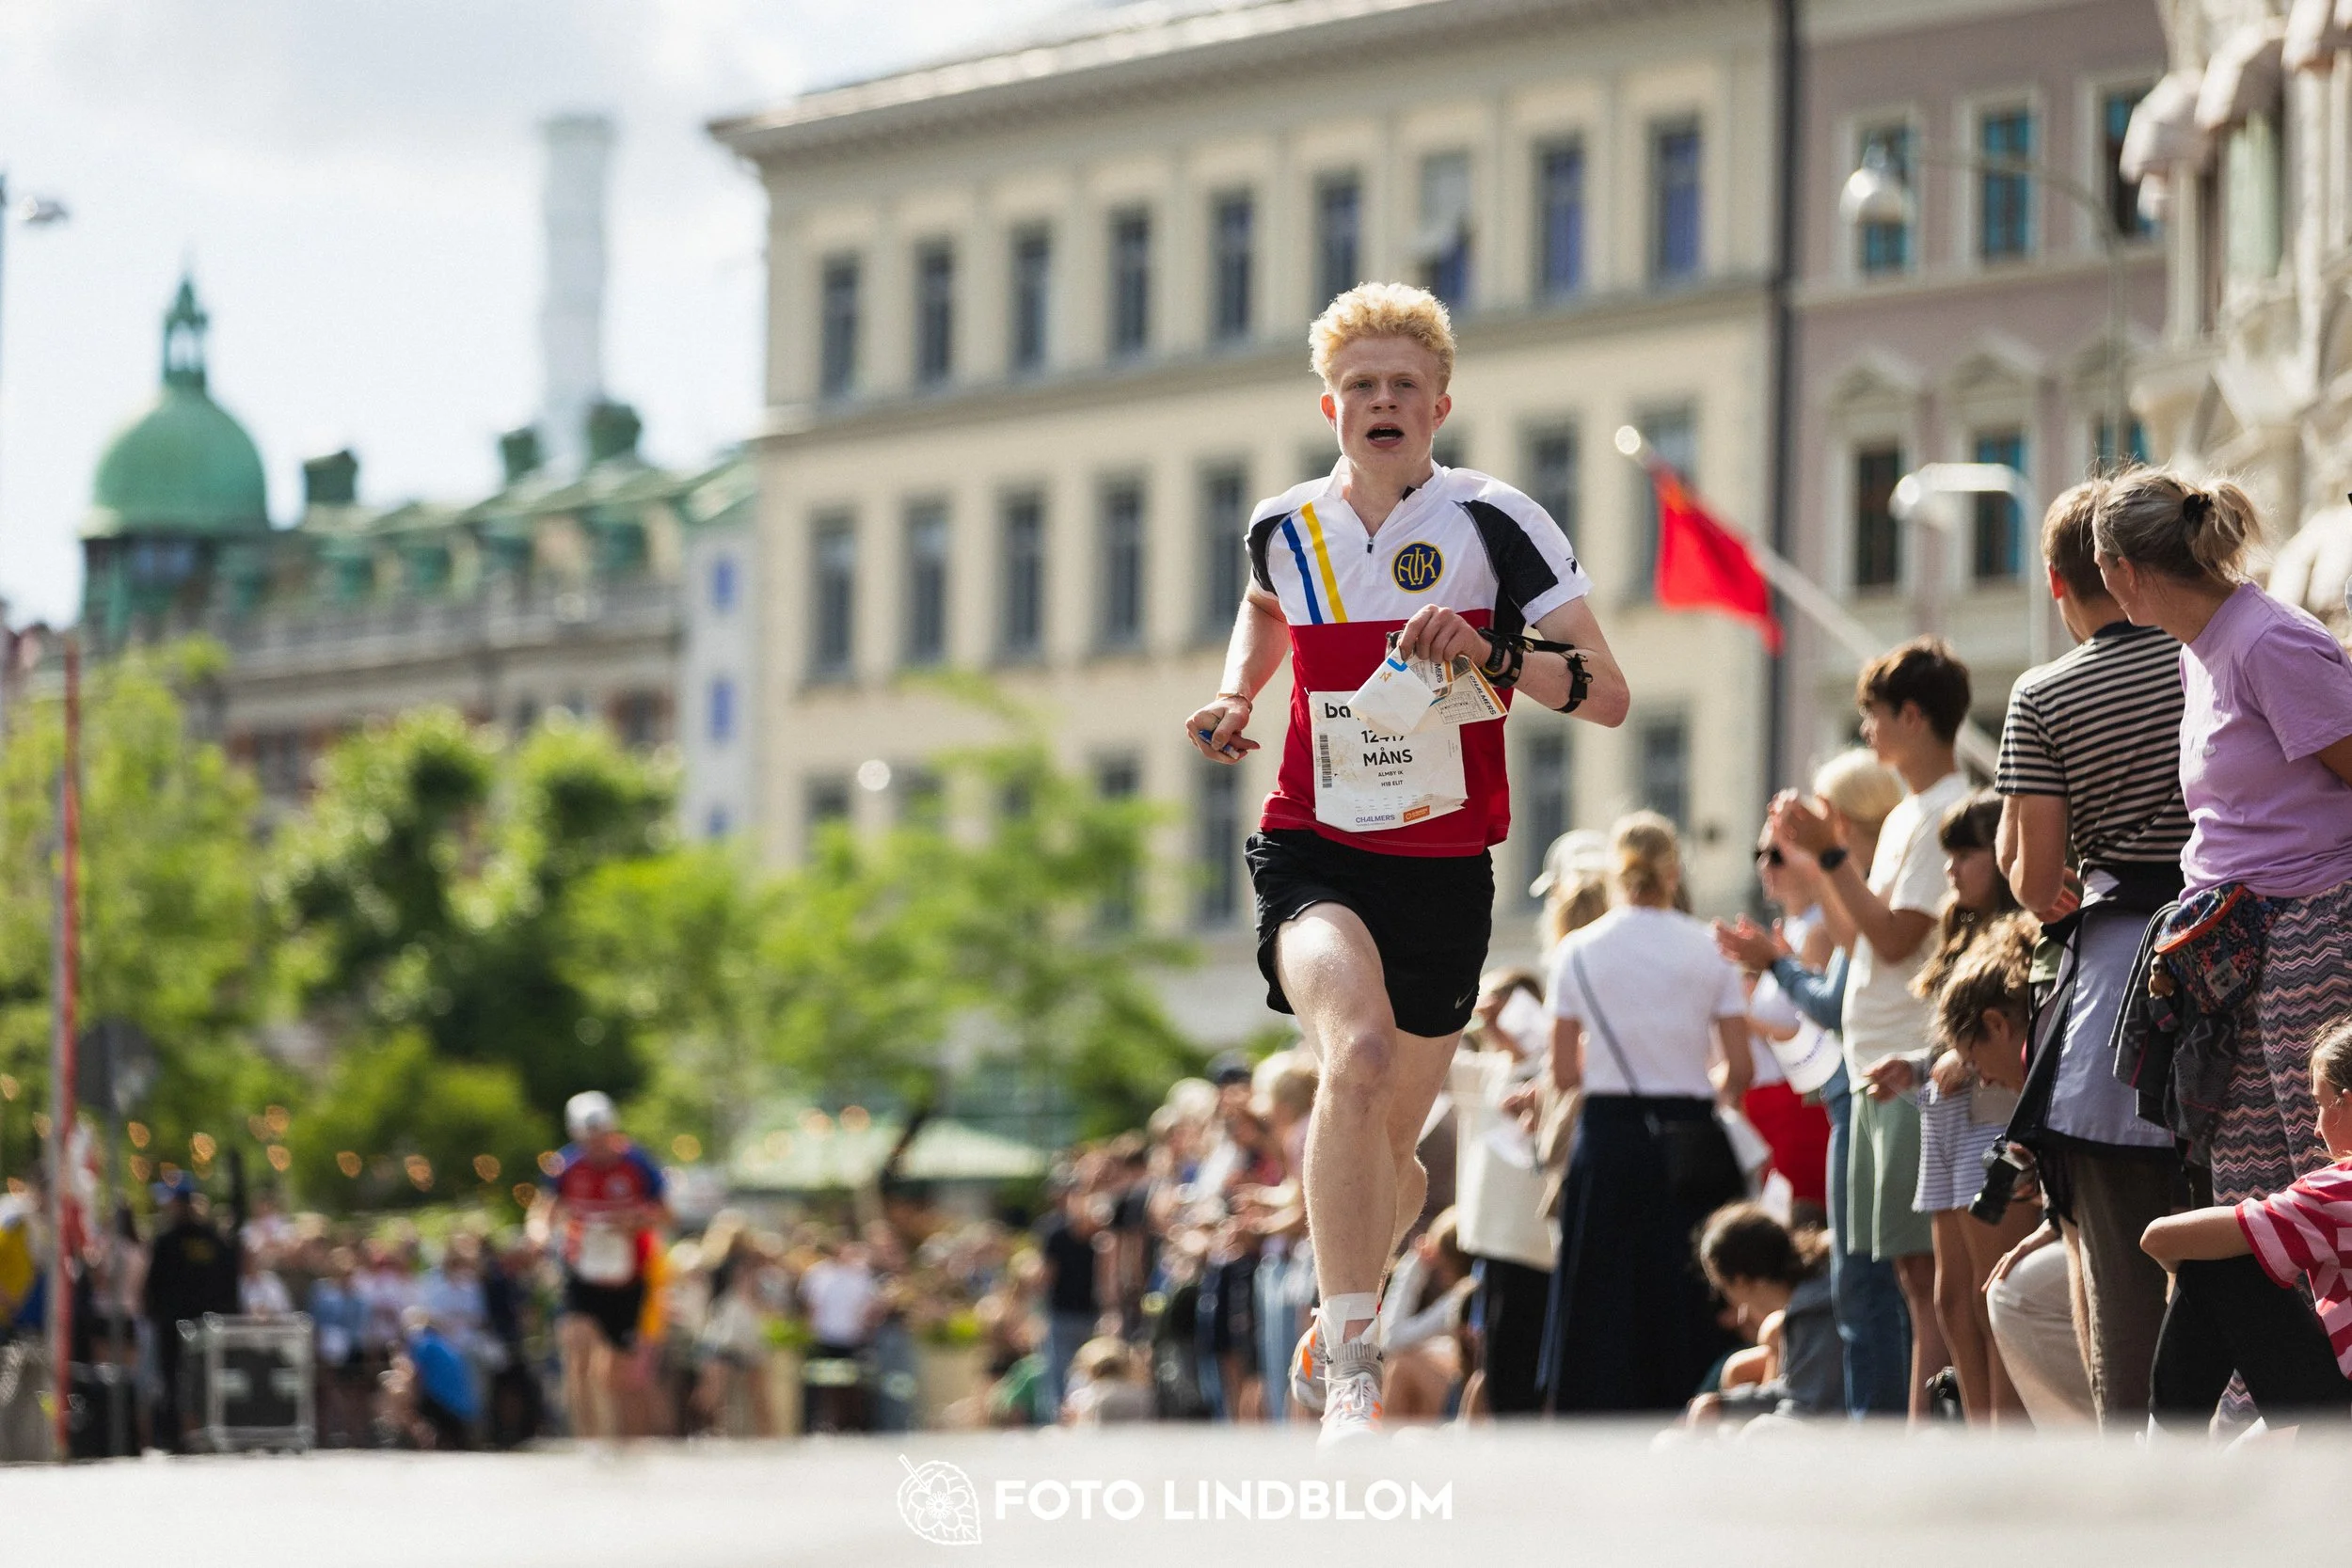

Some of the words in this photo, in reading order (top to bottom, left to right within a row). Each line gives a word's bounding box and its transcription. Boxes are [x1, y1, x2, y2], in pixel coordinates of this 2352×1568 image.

[1397, 546, 1438, 586] AIK
[1434, 663, 1444, 684] MERS
[1470, 674, 1498, 716] CHALMERS
[1362, 746, 1413, 768] MÅNS
[1355, 814, 1396, 824] CHALMERS
